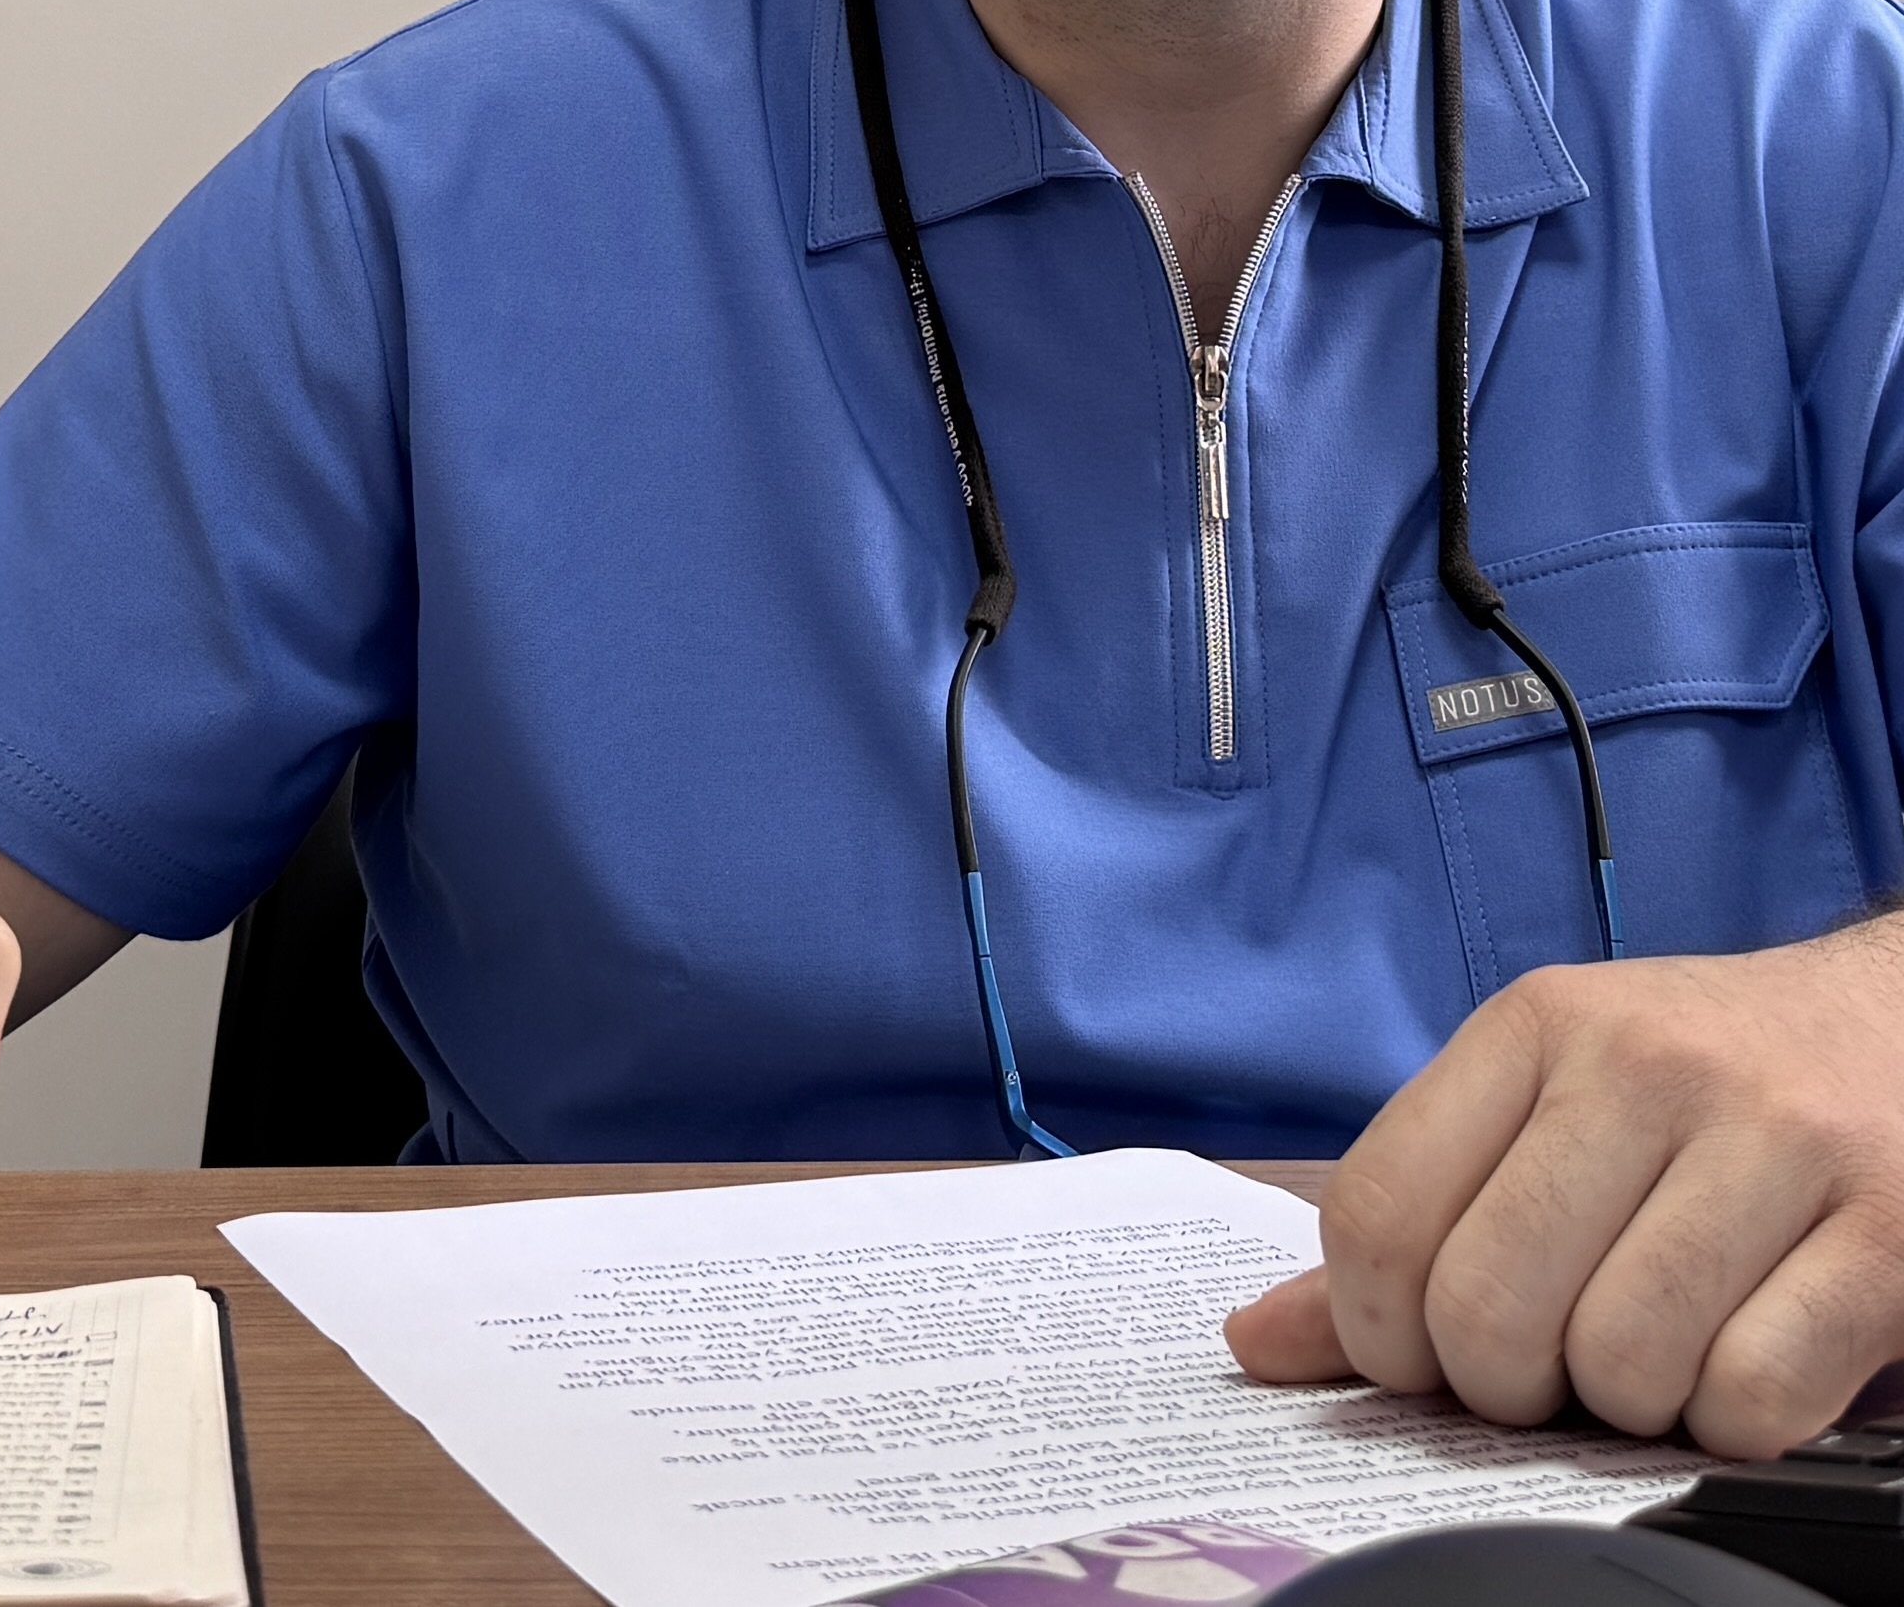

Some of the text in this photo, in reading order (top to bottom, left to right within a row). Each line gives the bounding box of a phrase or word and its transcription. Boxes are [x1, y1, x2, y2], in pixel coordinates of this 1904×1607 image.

[1437, 677, 1542, 722] NOTUS
[1144, 1347, 1231, 1364] ortaya
[1029, 1369, 1134, 1385] riskinin
[1018, 1384, 1089, 1397] kana
[764, 1401, 812, 1411] elli
[821, 1396, 859, 1407] ile
[762, 1409, 828, 1423] kalp
[1190, 1398, 1356, 1422] bakterilerin
[768, 1405, 1135, 1447] tabloda bakteriler kalbin
[1136, 1412, 1180, 1425] yol
[927, 1431, 991, 1447] akut
[662, 1452, 771, 1465] tehlike
[779, 1442, 873, 1459] hayati
[1232, 1448, 1336, 1466] sistemi
[1148, 1458, 1228, 1473] bunu
[1292, 1458, 1373, 1474] Buna
[855, 1472, 938, 1488] genel
[1028, 1467, 1143, 1487] kontrol
[1102, 1464, 1287, 1493] bakteriyemi
[1099, 1477, 1298, 1508] kaynaklanan
[1424, 1483, 1502, 1500] daha
[693, 1497, 785, 1513] ancak
[1283, 1492, 1420, 1515] derinden
[868, 1515, 931, 1526] kan
[939, 1501, 1093, 1524] bakteriler
[1304, 1508, 1391, 1528] Oysa
[768, 1556, 880, 1572] sistem
[888, 1551, 938, 1564] iki
